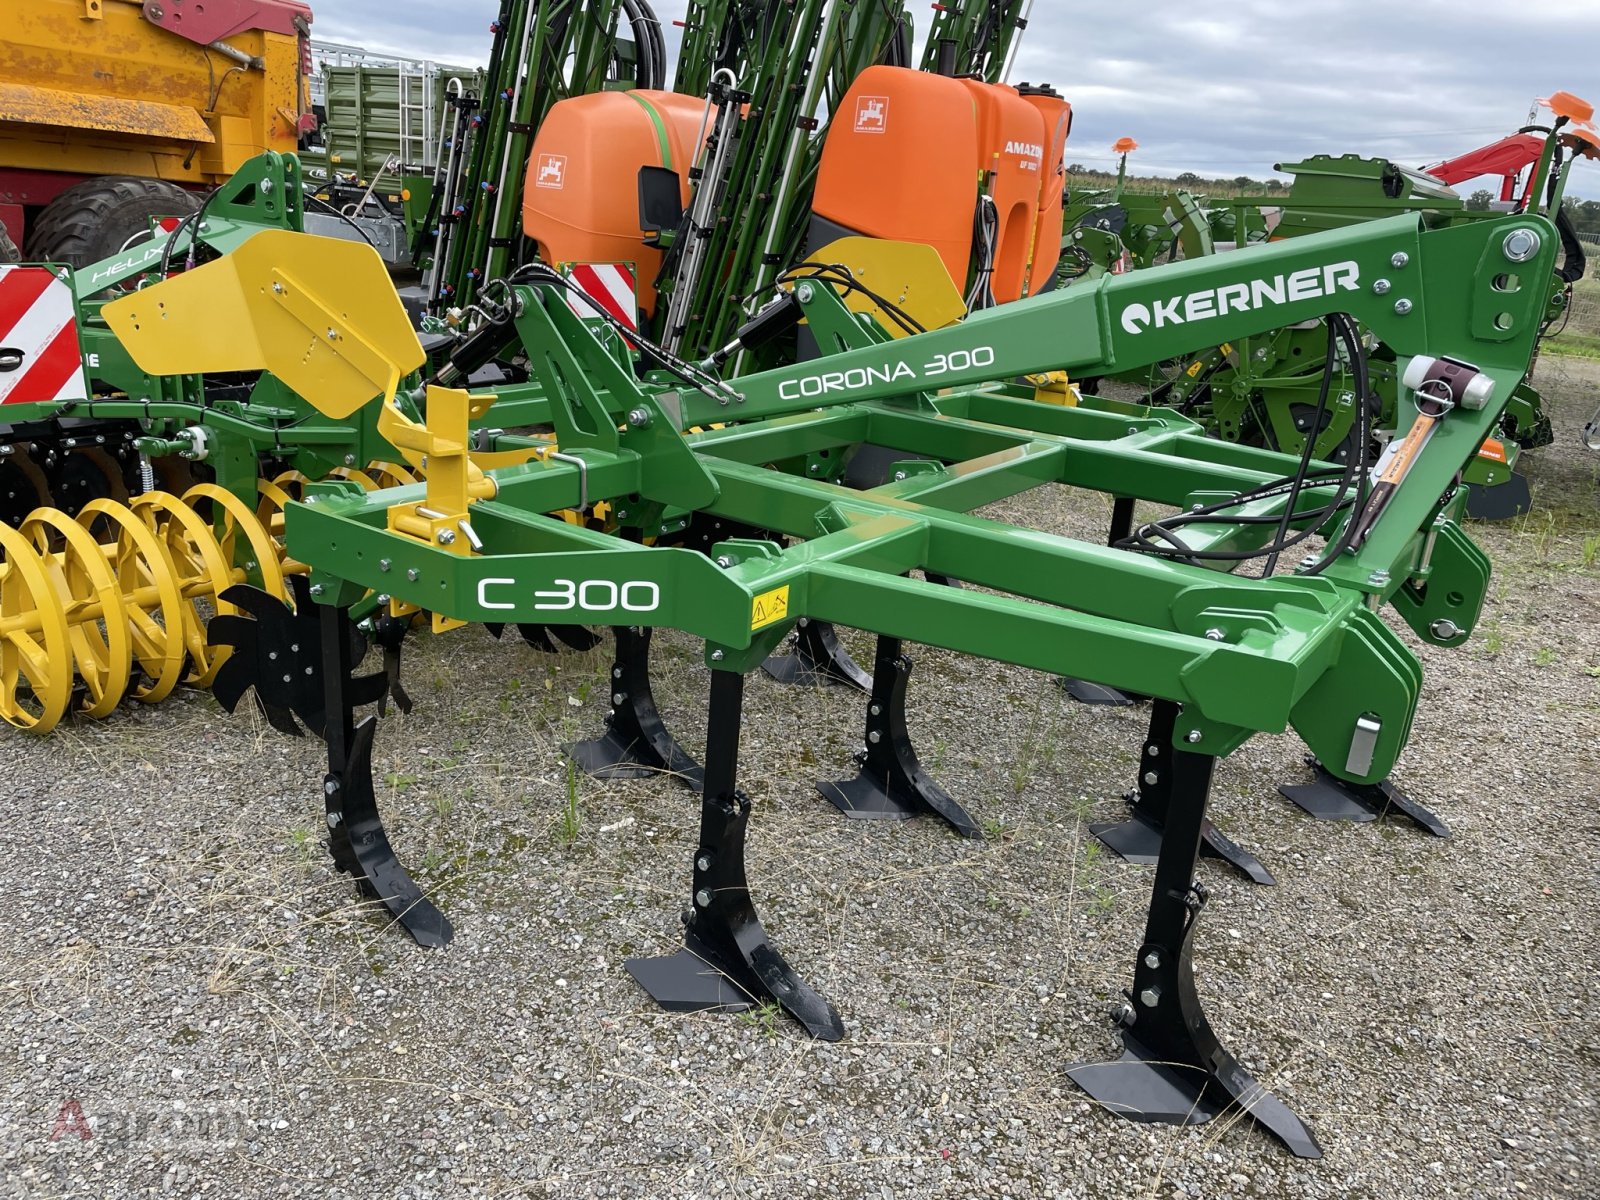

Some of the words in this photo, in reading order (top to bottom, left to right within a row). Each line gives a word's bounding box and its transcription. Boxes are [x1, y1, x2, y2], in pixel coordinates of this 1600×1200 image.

[91, 242, 167, 283] HELIX
[1152, 260, 1360, 328] KERNER
[778, 361, 917, 400] CORONA
[923, 346, 995, 376] 300
[477, 577, 516, 609] C
[534, 579, 660, 611] 300
